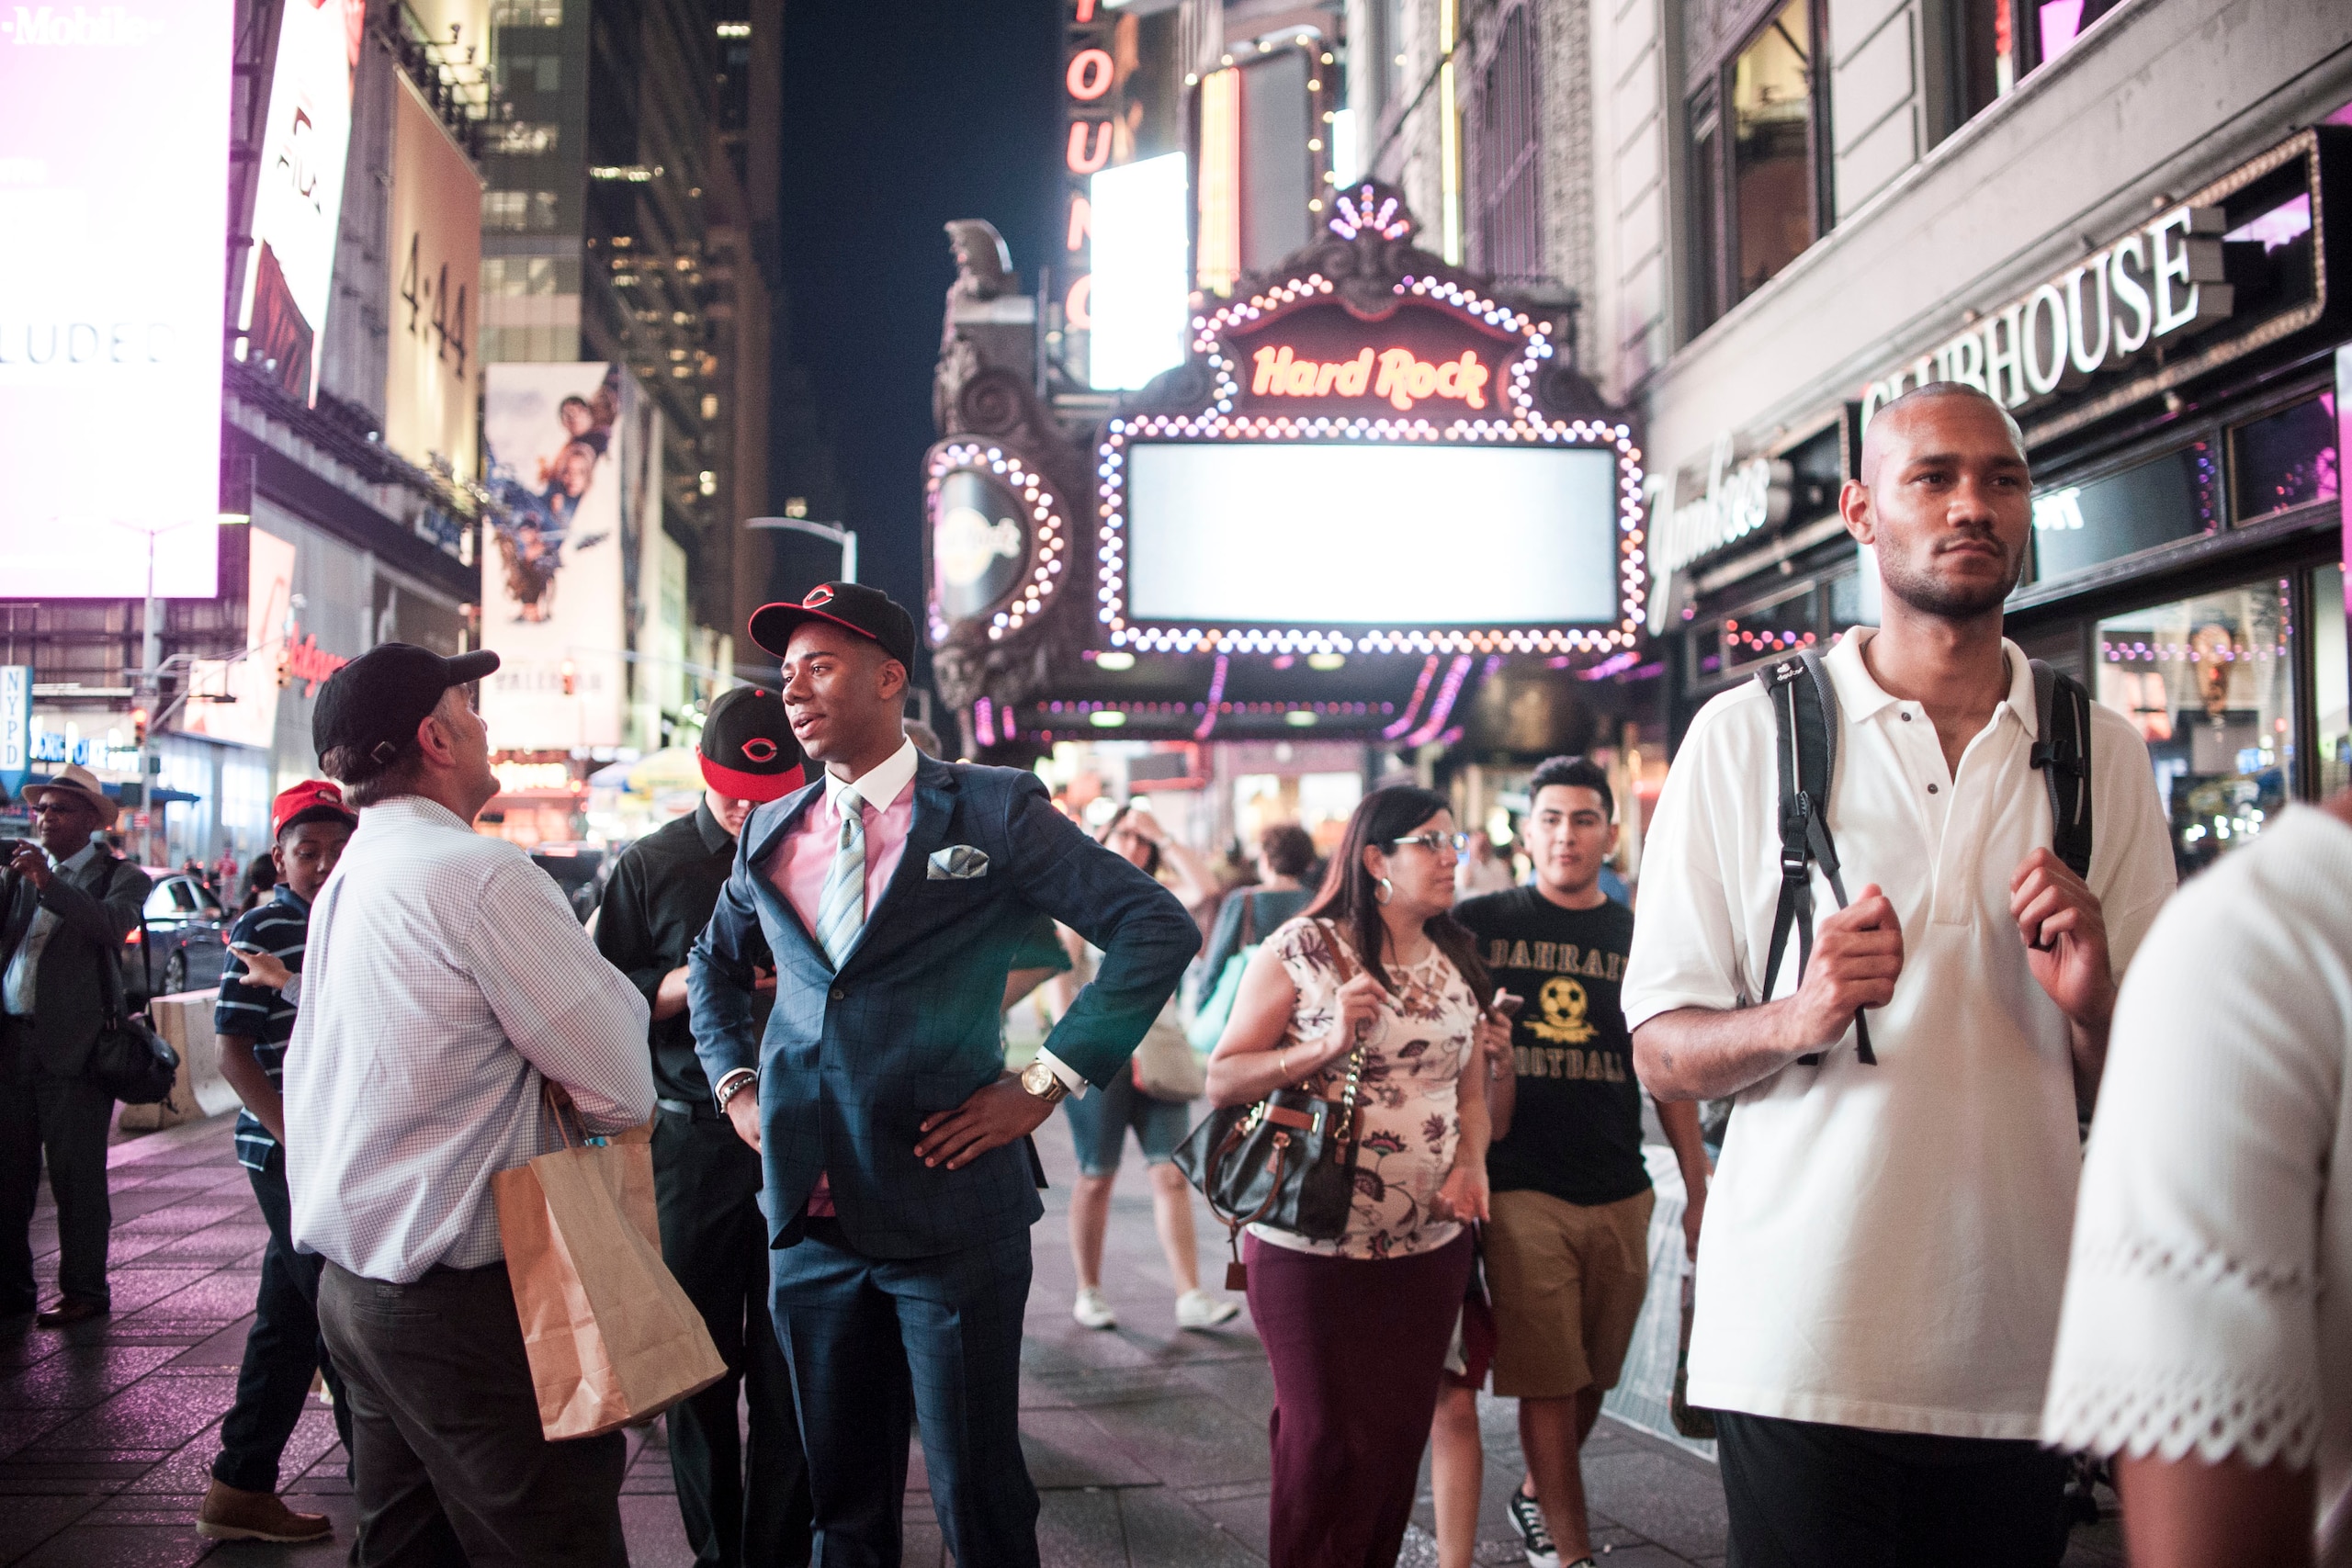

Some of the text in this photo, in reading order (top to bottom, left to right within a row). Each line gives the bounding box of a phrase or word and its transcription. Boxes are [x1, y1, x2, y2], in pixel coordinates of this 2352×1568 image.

[401, 232, 467, 378] 4:44
[1252, 345, 1489, 411] Hard Rock
[6, 671, 19, 765] NYPD
[1483, 938, 1628, 982] BAHRAI
